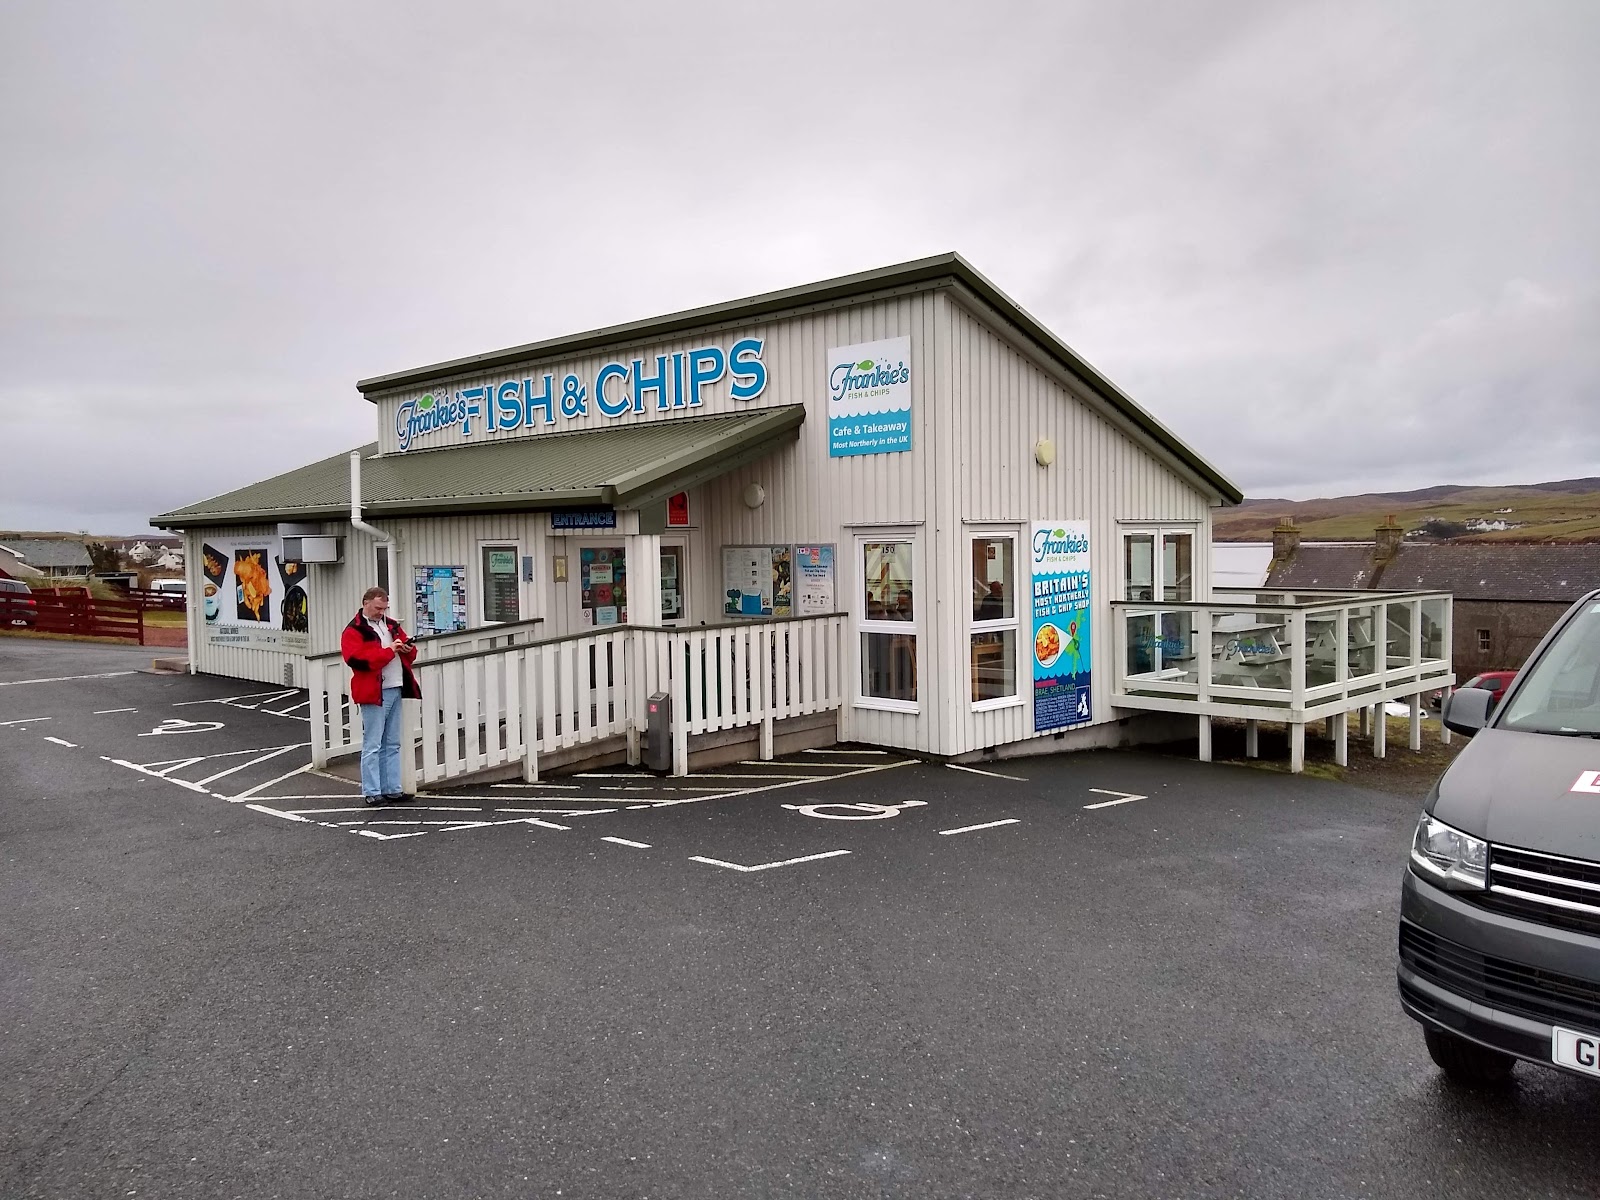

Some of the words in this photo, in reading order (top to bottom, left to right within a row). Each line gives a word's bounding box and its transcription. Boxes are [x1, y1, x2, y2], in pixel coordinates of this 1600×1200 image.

[830, 361, 910, 401] Frankie's
[396, 391, 467, 452] Frankie's
[461, 371, 556, 436] FISH
[560, 373, 588, 418] &
[595, 337, 768, 418] CHIPS
[870, 388, 890, 397] CHIPS
[833, 425, 852, 437] Cafe
[854, 425, 861, 435] &
[862, 422, 907, 434] Takeaway
[849, 438, 878, 448] Northerly
[879, 437, 885, 445] in
[887, 436, 897, 444] the
[898, 435, 908, 443] UK
[553, 511, 614, 526] ENTRANCE
[881, 546, 895, 554] 150
[1033, 528, 1089, 563] Frankie's
[1034, 574, 1088, 597] BRITAIN'S
[1034, 596, 1053, 608] MOST
[1054, 590, 1089, 604] NORTHERLY
[1035, 608, 1050, 618] FISH
[1051, 606, 1056, 615] &
[1058, 602, 1072, 614] CHIP
[1074, 599, 1090, 610] SHOP
[1575, 1037, 1600, 1070] G
